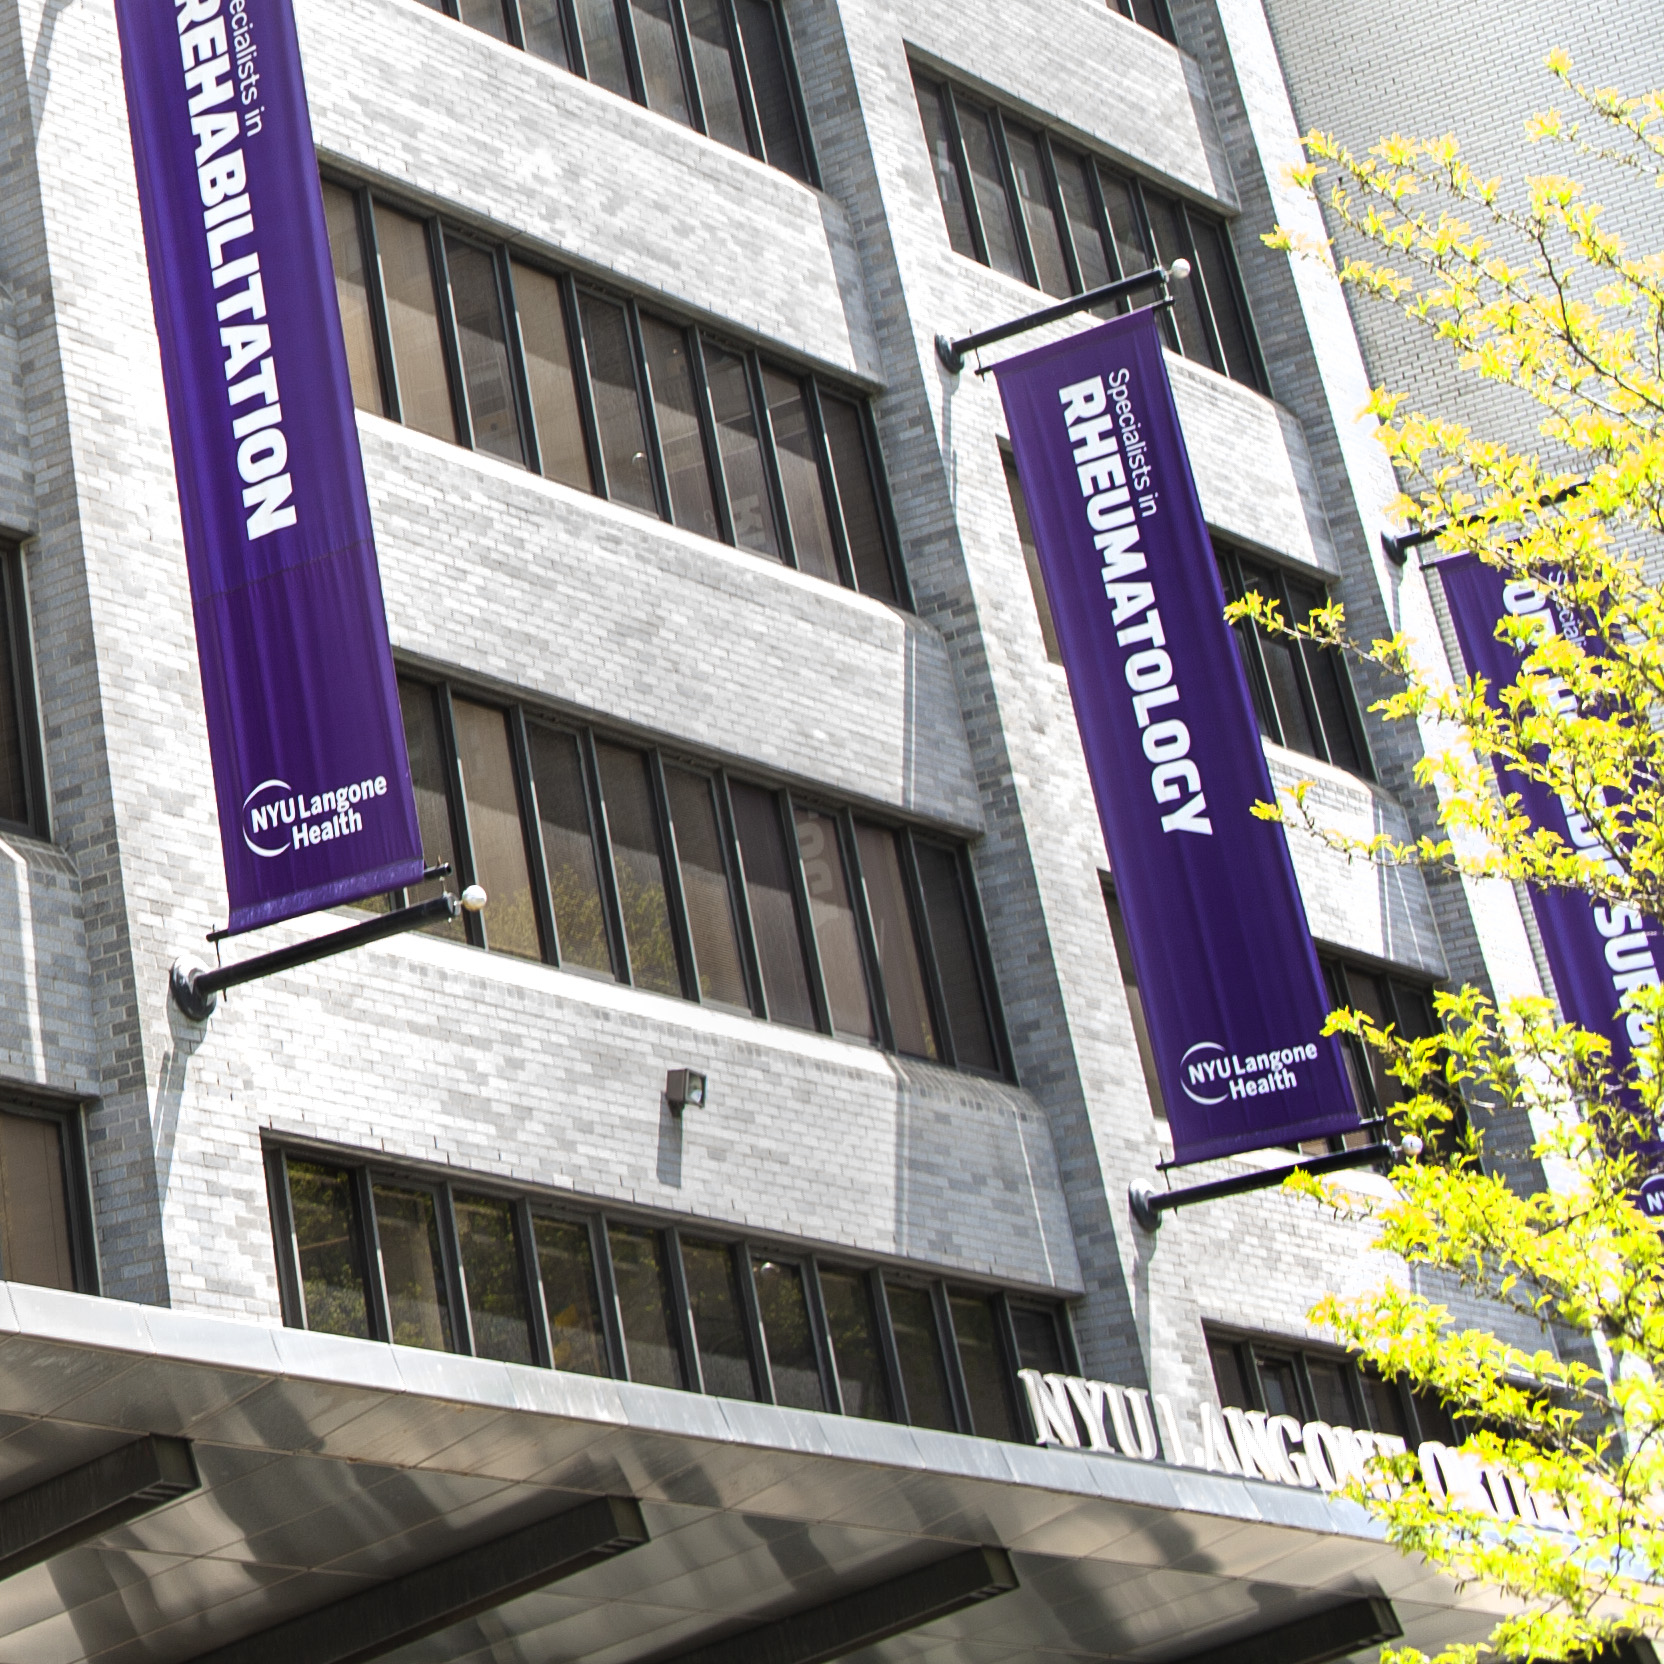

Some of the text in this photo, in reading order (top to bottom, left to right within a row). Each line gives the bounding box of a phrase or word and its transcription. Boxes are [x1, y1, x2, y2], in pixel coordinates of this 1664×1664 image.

[244, 106, 265, 137] in
[1108, 368, 1158, 518] Specialists in
[1058, 374, 1214, 836] RHEUMATOLOGY
[250, 775, 388, 834] NYU Langone
[291, 807, 363, 851] Health
[1187, 1042, 1318, 1086] NYU Langone
[1228, 1067, 1298, 1101] Health
[1018, 1368, 1159, 1461] NYU
